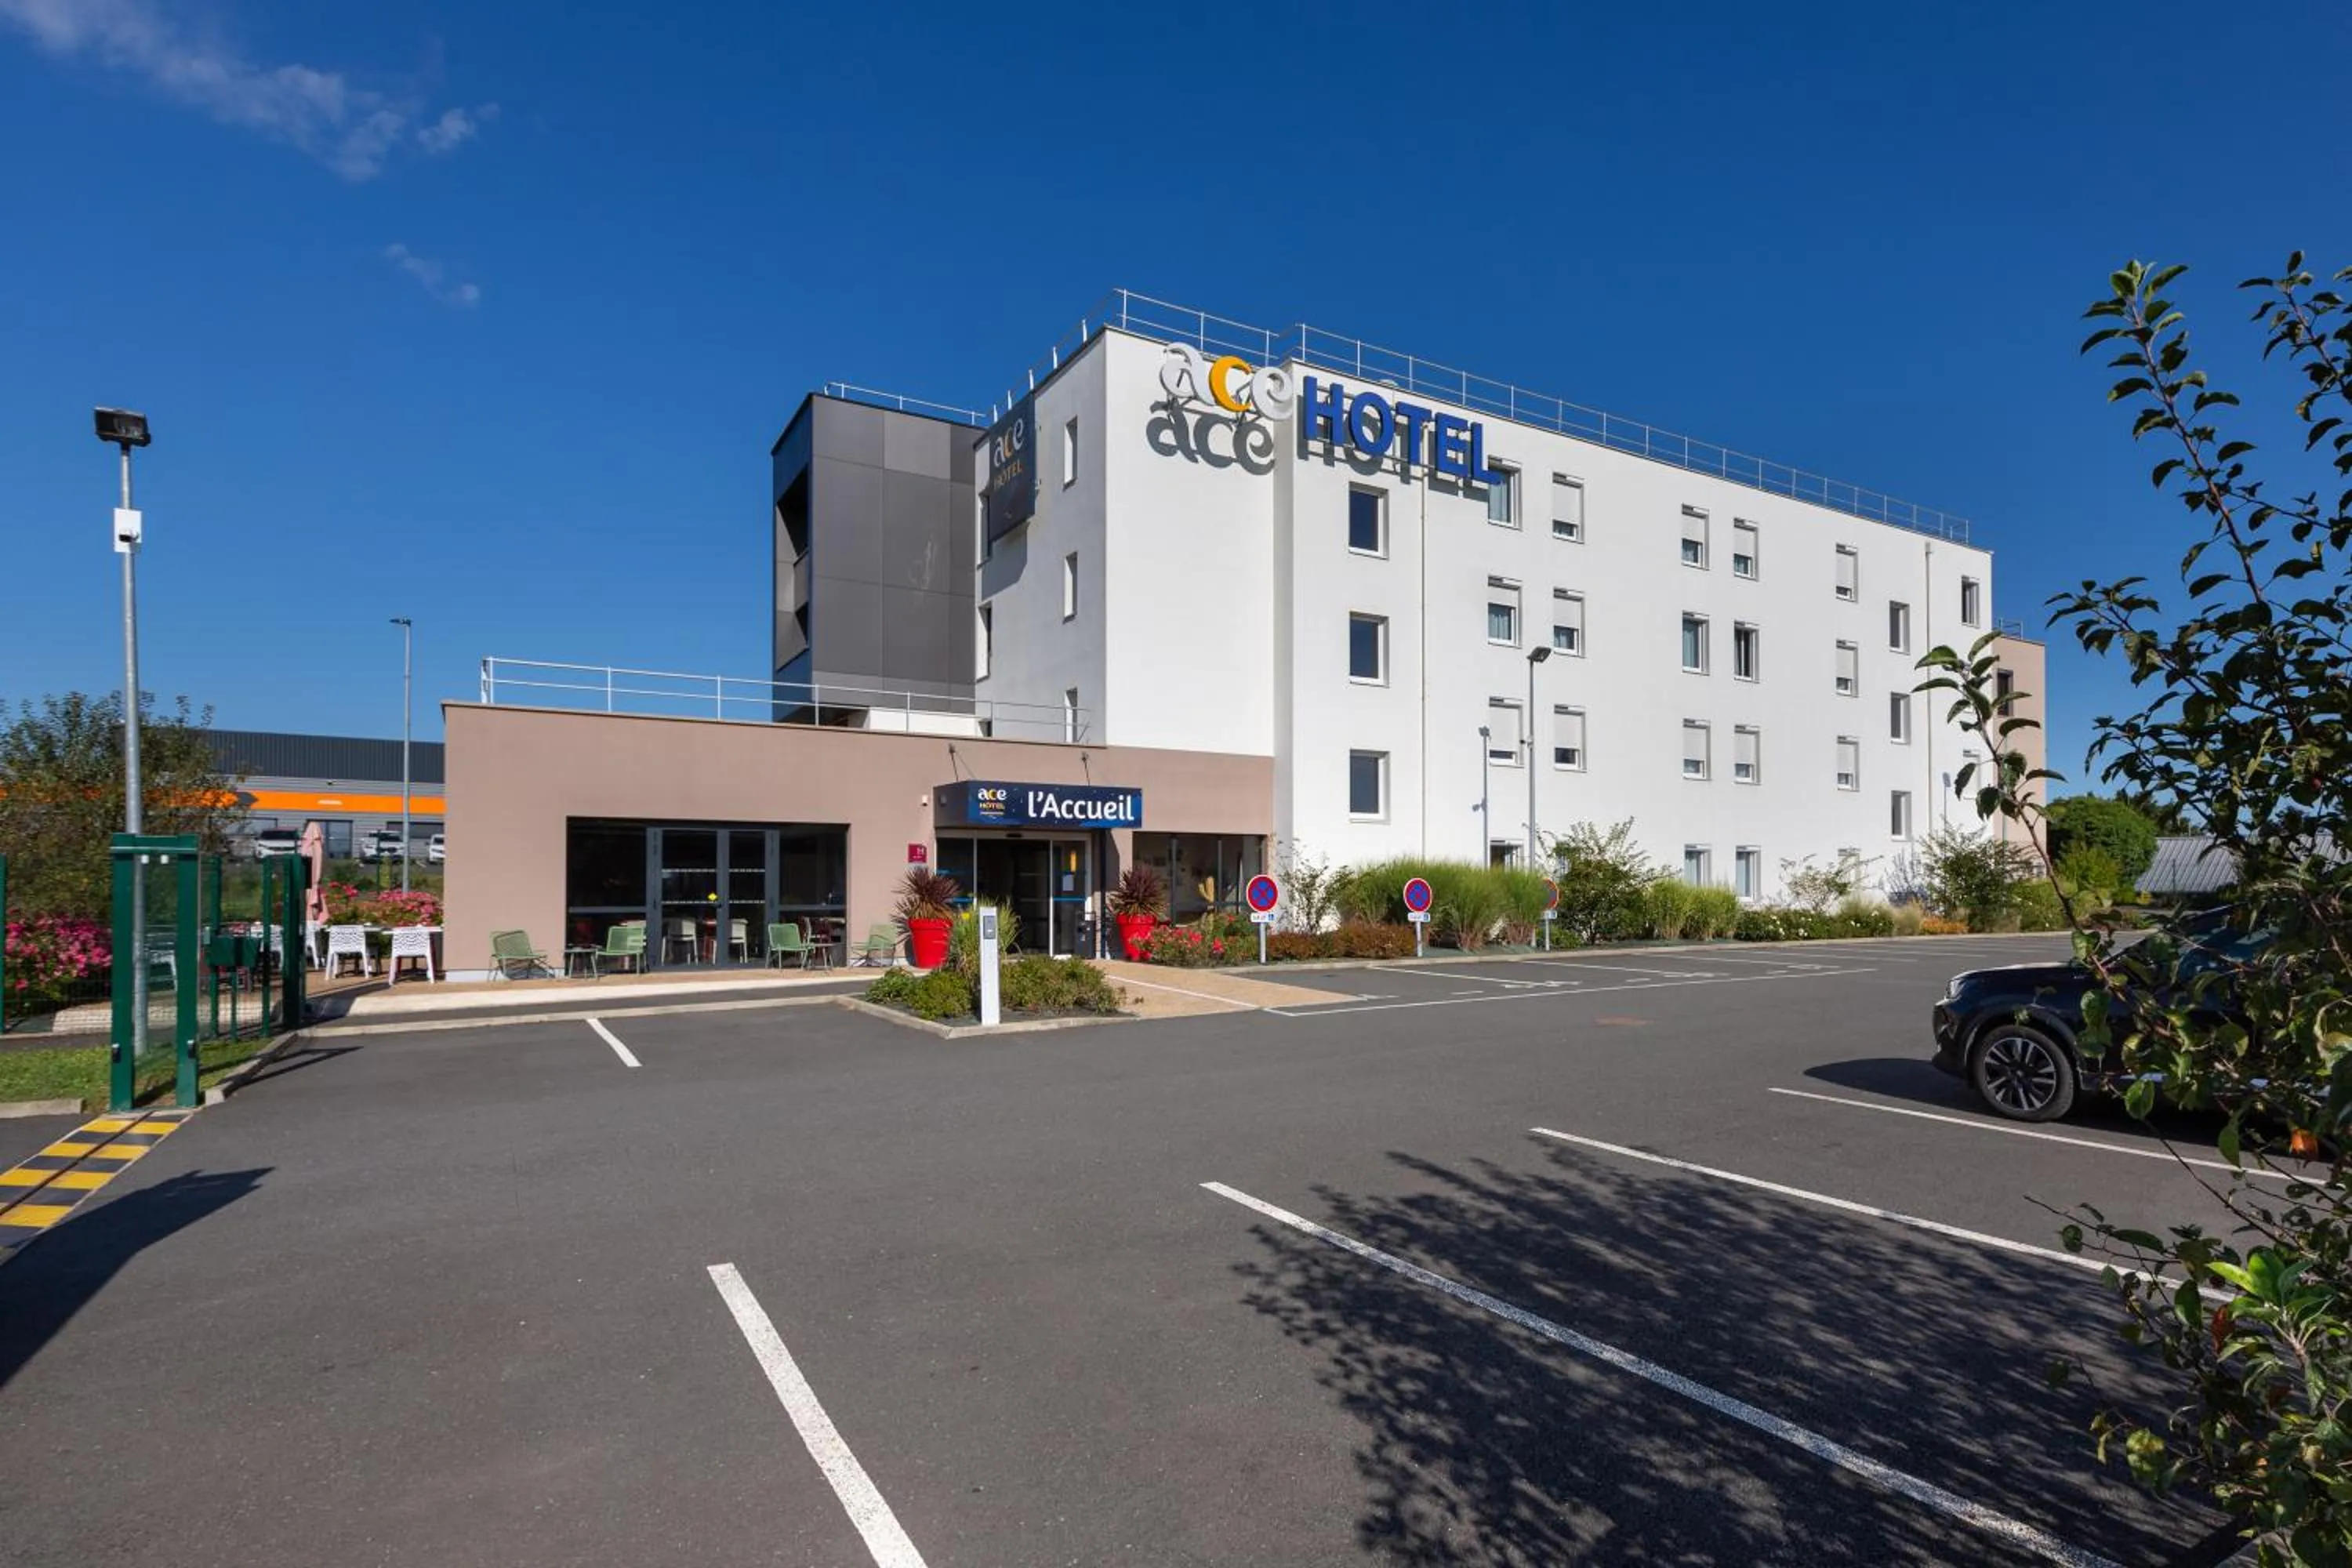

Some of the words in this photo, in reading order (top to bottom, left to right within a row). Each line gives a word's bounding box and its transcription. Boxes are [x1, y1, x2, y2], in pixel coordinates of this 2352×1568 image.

[1160, 342, 1294, 421] ace
[1303, 376, 1503, 485] HOTEL
[993, 418, 1023, 467] ace
[978, 788, 1007, 800] ace
[1028, 791, 1135, 821] l'Accueil
